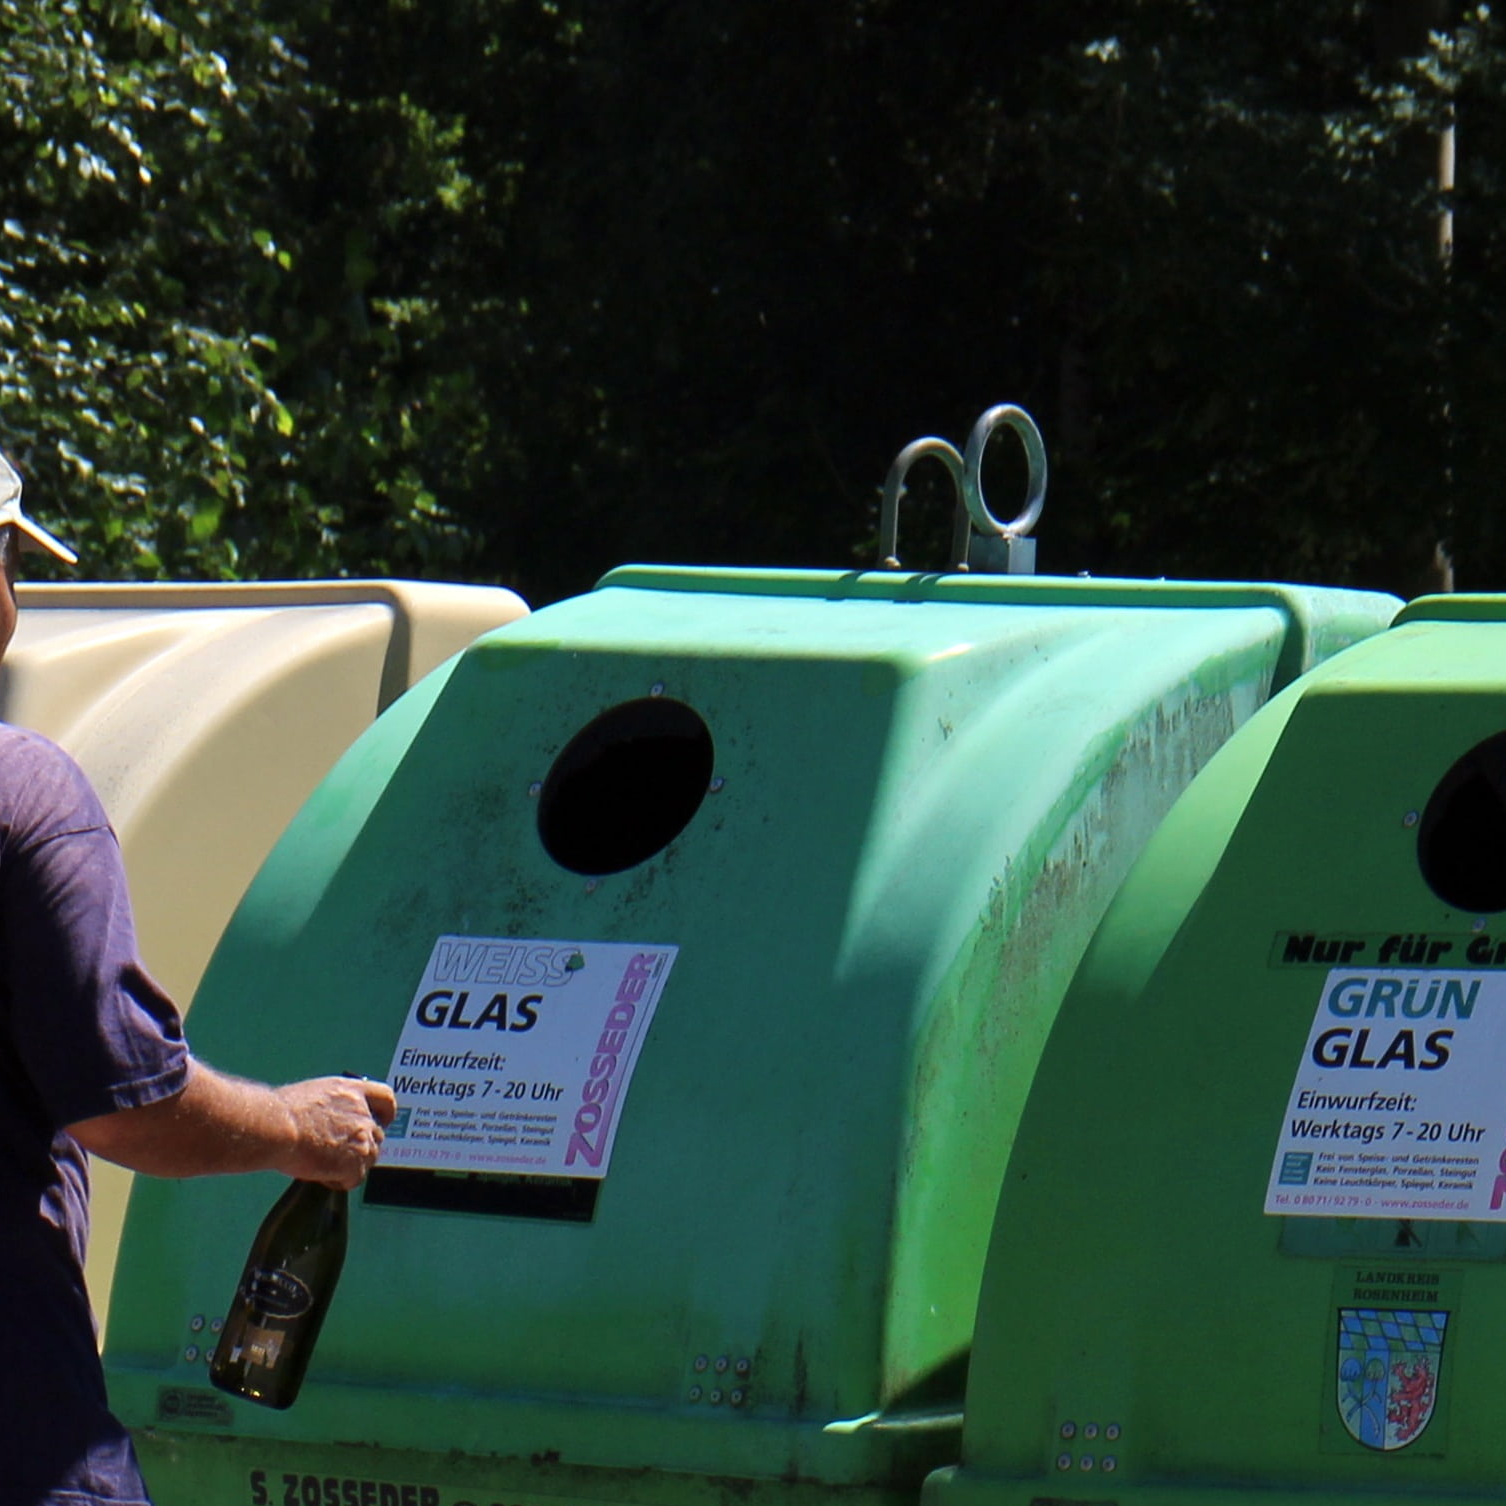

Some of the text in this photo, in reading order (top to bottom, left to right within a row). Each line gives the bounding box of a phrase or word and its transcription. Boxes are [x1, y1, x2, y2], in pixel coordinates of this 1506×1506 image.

[433, 942, 582, 987] WEISS
[1282, 935, 1365, 963] Nur
[1378, 935, 1453, 964] für
[415, 989, 543, 1033] GLAS
[1328, 977, 1481, 1020] GRÜN
[400, 1048, 507, 1072] Einwurfzeit:
[564, 953, 658, 1168] ZOSSEDER
[1312, 1027, 1454, 1070] GLAS
[394, 1075, 475, 1101] Werktags
[483, 1080, 494, 1096] 7
[503, 1082, 526, 1099] 20
[531, 1083, 564, 1101] Uhr
[1297, 1090, 1417, 1112] Einwurfzeit:
[1291, 1119, 1384, 1144] Werktags
[1393, 1122, 1404, 1139] 7
[1416, 1123, 1442, 1141] 20
[1448, 1124, 1485, 1143] Uhr
[250, 1470, 273, 1506] S.
